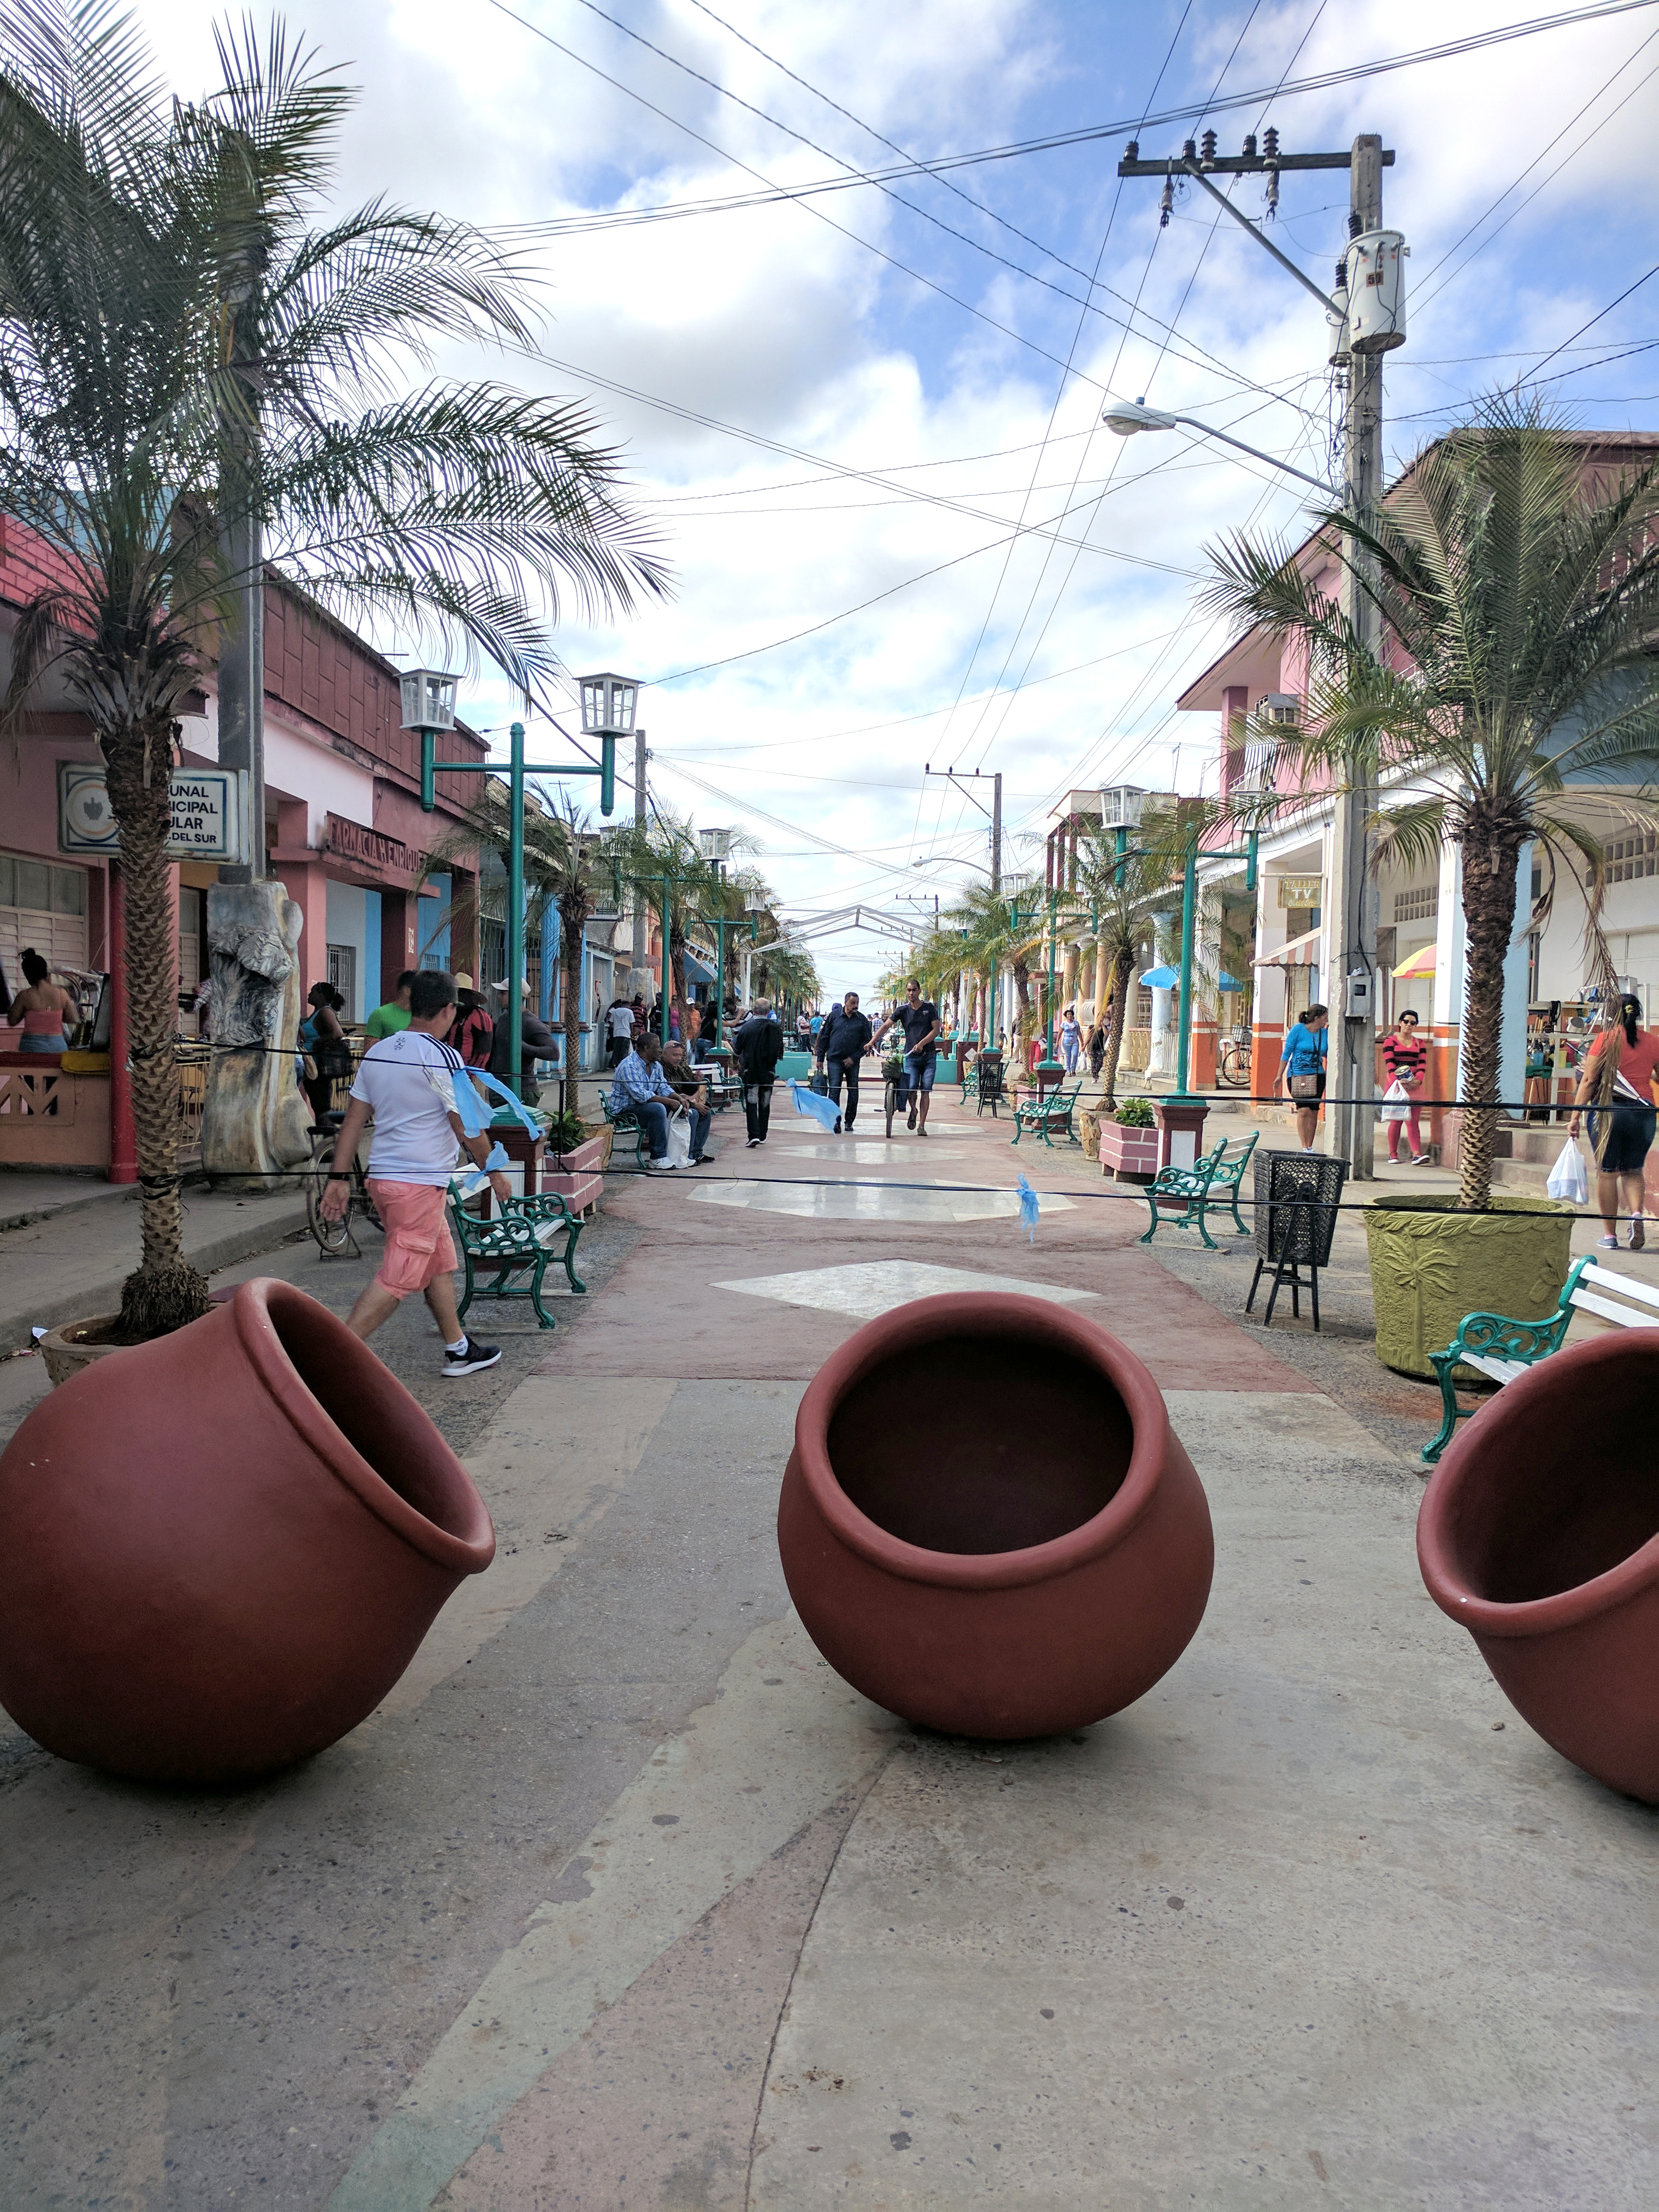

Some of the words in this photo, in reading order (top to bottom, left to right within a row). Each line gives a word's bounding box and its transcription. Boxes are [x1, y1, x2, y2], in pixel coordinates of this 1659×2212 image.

[1368, 274, 1381, 285] 50
[167, 785, 209, 798] UNAL
[194, 833, 216, 843] SUR
[329, 816, 377, 860] FARMACIA
[1285, 880, 1320, 889] TALLER
[1292, 889, 1311, 899] TV
